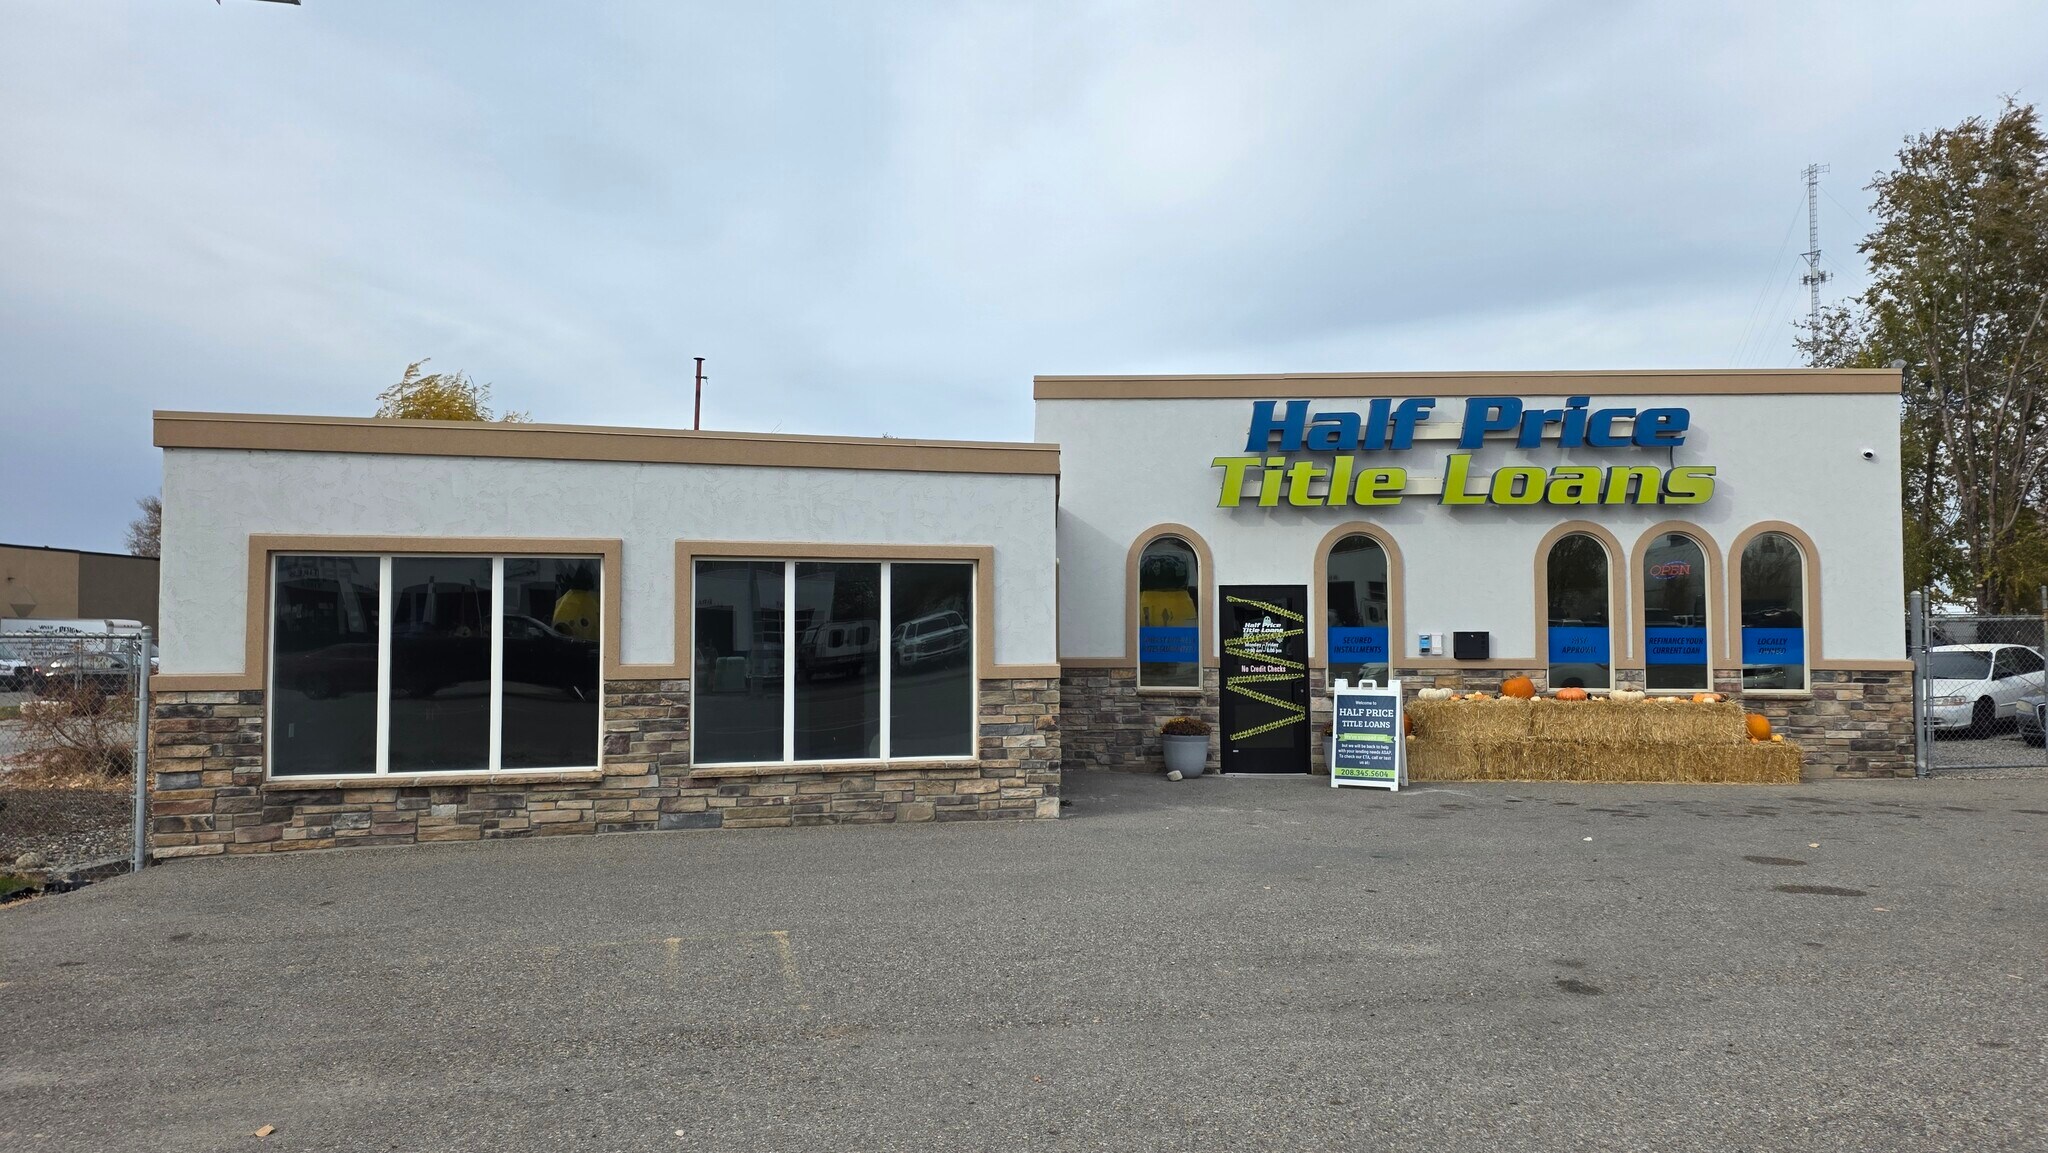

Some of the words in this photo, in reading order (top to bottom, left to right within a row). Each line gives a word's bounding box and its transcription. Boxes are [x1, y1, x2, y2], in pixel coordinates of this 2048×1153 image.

[1244, 397, 1436, 452] Half
[1457, 396, 1691, 449] Price
[1211, 454, 1407, 508] Title
[1438, 453, 1717, 506] Loans
[1650, 564, 1691, 576] OPEN
[1343, 636, 1373, 644] SECURED
[1648, 637, 1686, 645] REFINANCE
[1686, 637, 1704, 645] YOUR
[1333, 646, 1382, 654] INSTALLMENTS
[1561, 646, 1597, 654] APPROVAL
[1652, 647, 1682, 655] CURRENT
[1683, 647, 1700, 655] LOAN
[1758, 647, 1787, 655] OWNED
[1339, 708, 1364, 716] HALF
[1366, 709, 1394, 717] PRICE
[1341, 768, 1389, 778] 208.345.5604
